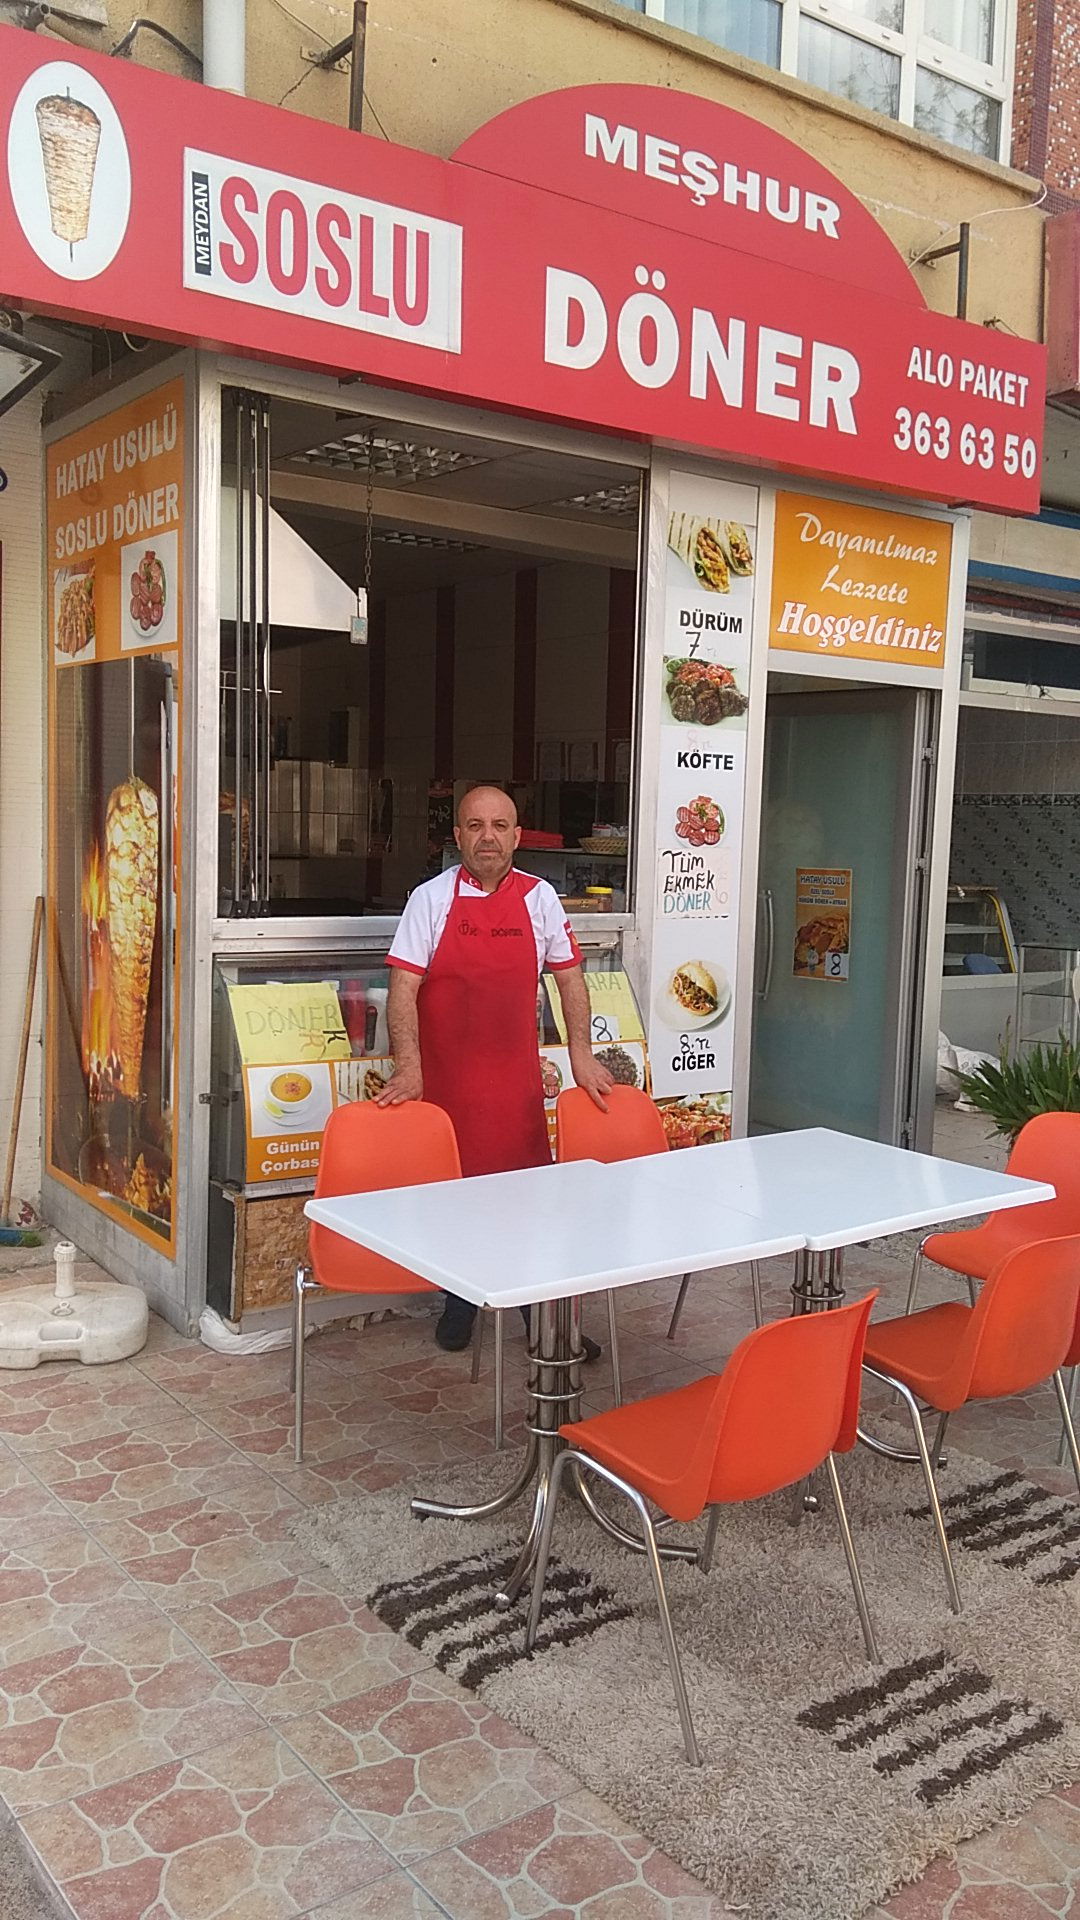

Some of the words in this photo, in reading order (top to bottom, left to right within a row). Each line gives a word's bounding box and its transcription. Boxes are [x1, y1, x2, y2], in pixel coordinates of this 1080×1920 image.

[584, 113, 840, 239] MEŞHUR
[194, 182, 209, 267] MEYDAN
[219, 176, 430, 327] SOSLU
[543, 264, 861, 435] DÖNER
[906, 346, 954, 388] ALO
[959, 361, 1030, 408] PAKET
[55, 443, 108, 499] HATAY
[112, 403, 177, 472] USULÜ
[893, 406, 951, 460] 363
[959, 424, 994, 469] 63
[1003, 435, 1037, 479] 50
[55, 509, 108, 559] SOSLU
[113, 482, 180, 541] DÖNER
[795, 512, 938, 566] Dayanılmaz
[820, 565, 909, 605] Lezzete
[679, 608, 743, 634] DÜRÜM
[776, 600, 944, 654] Hoşgeldiniz
[685, 631, 701, 658] 7
[677, 749, 734, 770] KÖFTE
[800, 875, 822, 884] HATAY
[663, 890, 712, 914] DÖNER
[831, 953, 842, 976] 8
[245, 1004, 340, 1035] DÖNER
[592, 1015, 613, 1041] 8
[671, 1051, 716, 1072] CİĞER
[266, 1140, 320, 1155] Günün
[260, 1157, 320, 1176] Çorbas
